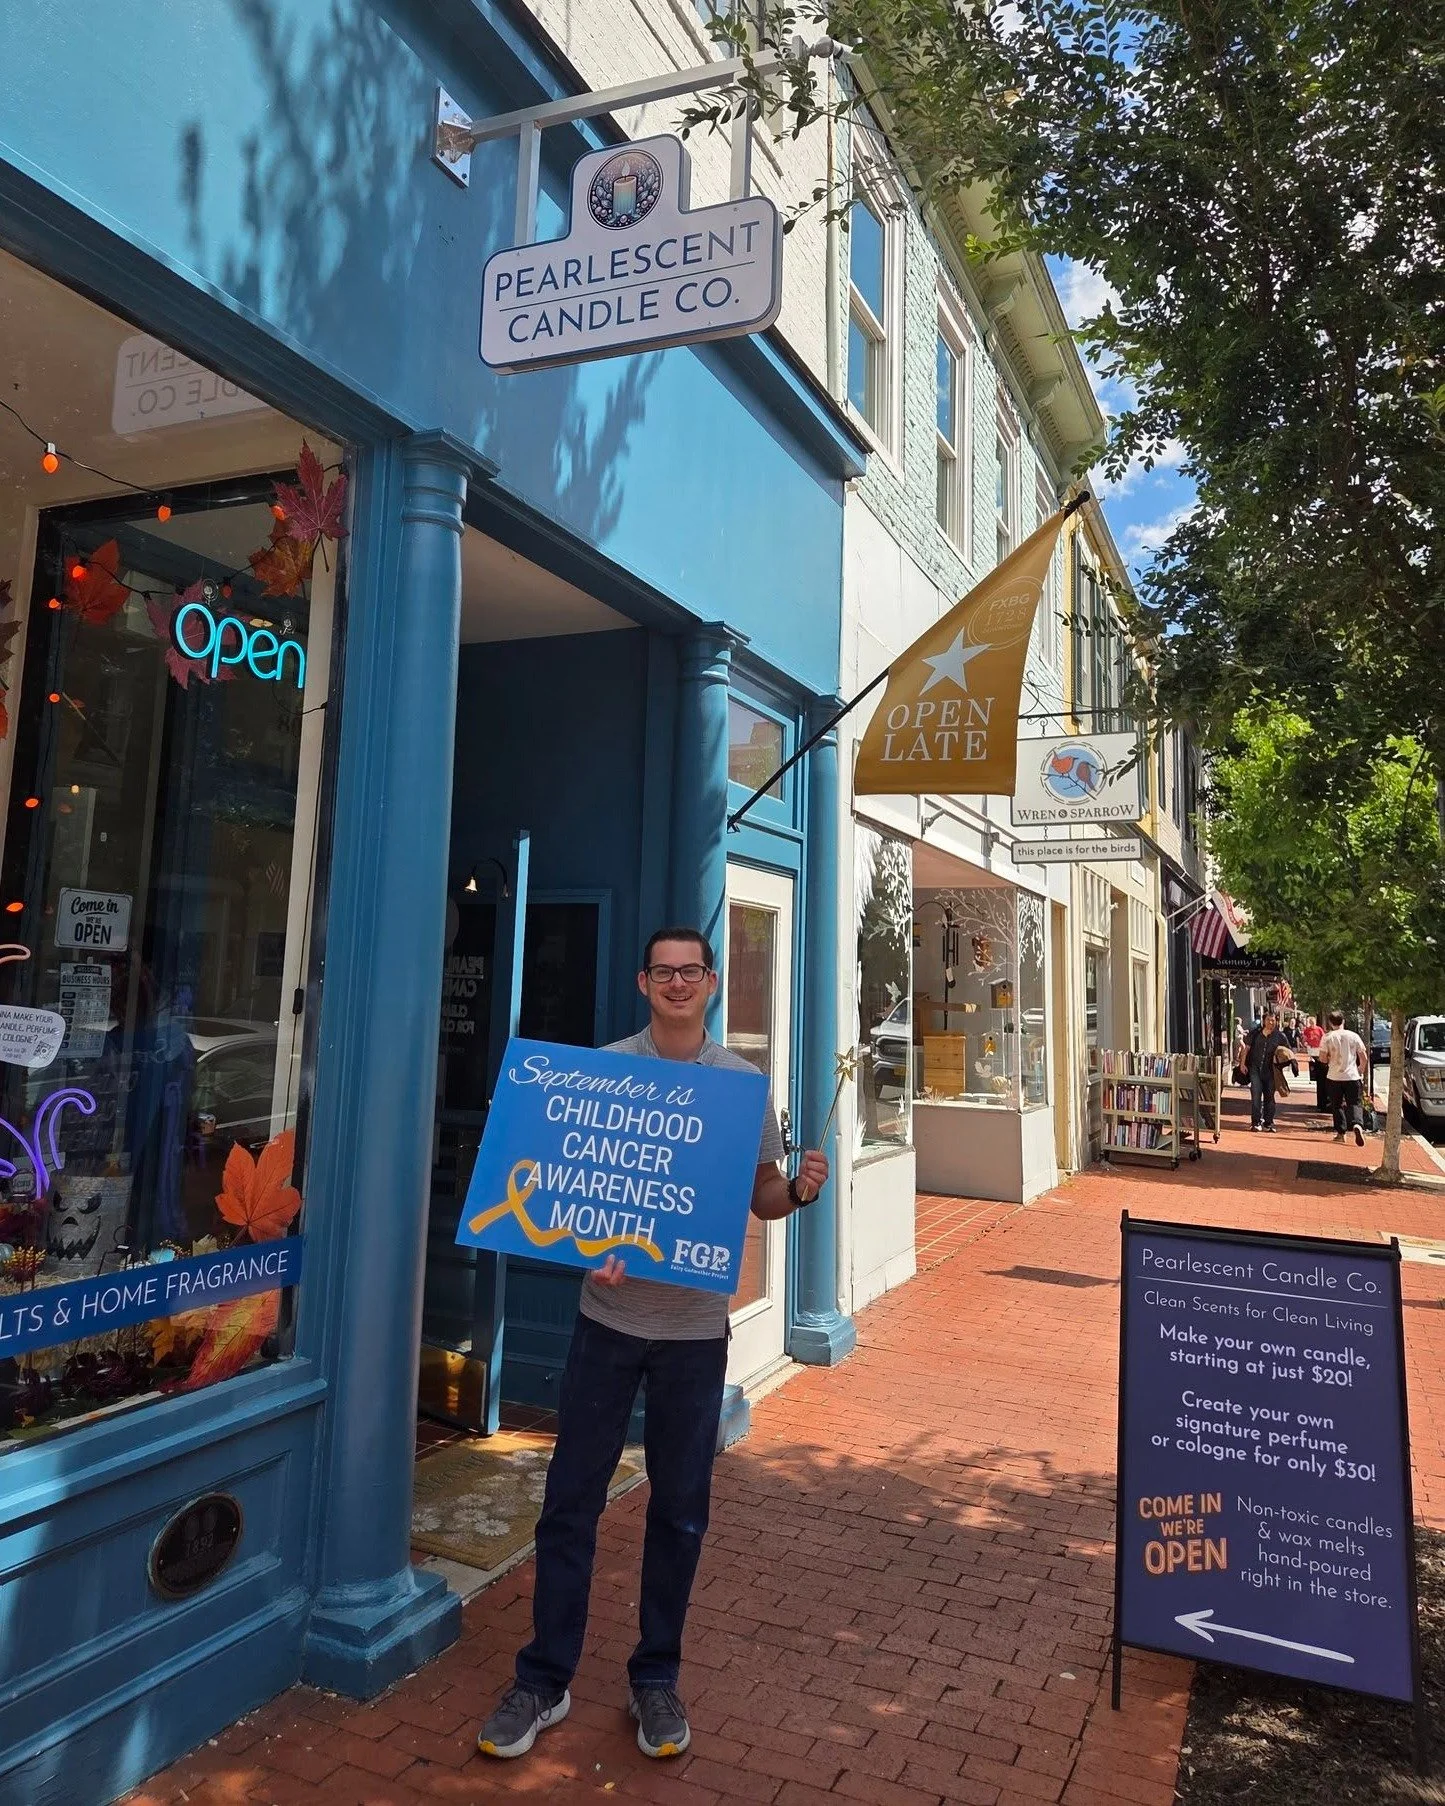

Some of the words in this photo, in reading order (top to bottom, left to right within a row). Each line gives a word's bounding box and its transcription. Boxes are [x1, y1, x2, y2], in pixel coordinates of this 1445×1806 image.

[495, 221, 760, 301] PEARLESCENT
[508, 290, 659, 343] CANDLE
[675, 277, 740, 313] CO.
[990, 593, 1030, 611] FXBG
[173, 602, 305, 688] Open
[887, 697, 995, 730] OPEN
[881, 731, 988, 762] LATE
[1017, 809, 1056, 820] WREN
[1070, 804, 1134, 818] SPARROW
[1018, 847, 1034, 856] this
[1037, 846, 1062, 857] place
[1066, 845, 1073, 854] is
[1075, 845, 1089, 854] for
[1092, 844, 1107, 854] the
[1110, 843, 1136, 853] birds
[71, 897, 105, 915] Come
[106, 899, 119, 913] in
[74, 922, 112, 944] OPEN
[62, 975, 91, 985] BUSINESS
[92, 976, 110, 985] HOURS
[13, 1011, 34, 1021] MAKE
[36, 1014, 54, 1024] YOUR
[2, 1033, 39, 1044] COLOGNE?
[509, 1055, 662, 1102] September
[666, 1084, 696, 1106] is
[546, 1095, 702, 1144] CHILDHOOD
[562, 1131, 673, 1175] CANCER
[523, 1161, 695, 1215] AWARENESS
[549, 1201, 655, 1245] MONTH
[53, 1297, 71, 1326] &
[81, 1278, 158, 1320] HOME
[166, 1250, 289, 1299] FRAGRANCE
[1142, 1249, 1253, 1279] Pearlescent
[1262, 1262, 1337, 1290] Candle
[1347, 1272, 1382, 1294] Co.
[1144, 1291, 1186, 1308] Clean
[1192, 1297, 1240, 1316] Scents
[1245, 1302, 1267, 1319] for
[1272, 1307, 1318, 1326] Clean
[1325, 1313, 1374, 1336] Living
[1159, 1323, 1209, 1345] Make
[1214, 1335, 1253, 1357] your
[1260, 1341, 1296, 1357] own
[1303, 1347, 1371, 1370] candle,
[1170, 1349, 1239, 1374] starting
[1246, 1358, 1264, 1374] at
[1271, 1361, 1305, 1381] just
[1312, 1365, 1353, 1388] $20!
[1181, 1390, 1243, 1415] Create
[1249, 1405, 1290, 1421] your
[1297, 1412, 1334, 1429] own
[1176, 1415, 1261, 1441] signature
[1268, 1430, 1349, 1455] perfume
[1151, 1433, 1170, 1448] or
[1176, 1437, 1247, 1461] cologne
[1254, 1447, 1280, 1467] for
[1287, 1454, 1327, 1478] only
[1334, 1459, 1376, 1482] $30!
[1139, 1494, 1194, 1519] COME
[1200, 1492, 1222, 1513] IN
[1237, 1496, 1319, 1526] Non-toxic
[1326, 1515, 1393, 1538] candles
[1160, 1518, 1205, 1537] WE'RE
[1258, 1521, 1272, 1540] &
[1278, 1530, 1311, 1547] wax
[1319, 1536, 1365, 1557] melts
[1144, 1537, 1228, 1575] OPEN
[1257, 1543, 1371, 1581] hand-poured
[1241, 1567, 1280, 1588] right
[1288, 1575, 1302, 1592] in
[1309, 1579, 1337, 1599] the
[1344, 1588, 1393, 1609] store.
